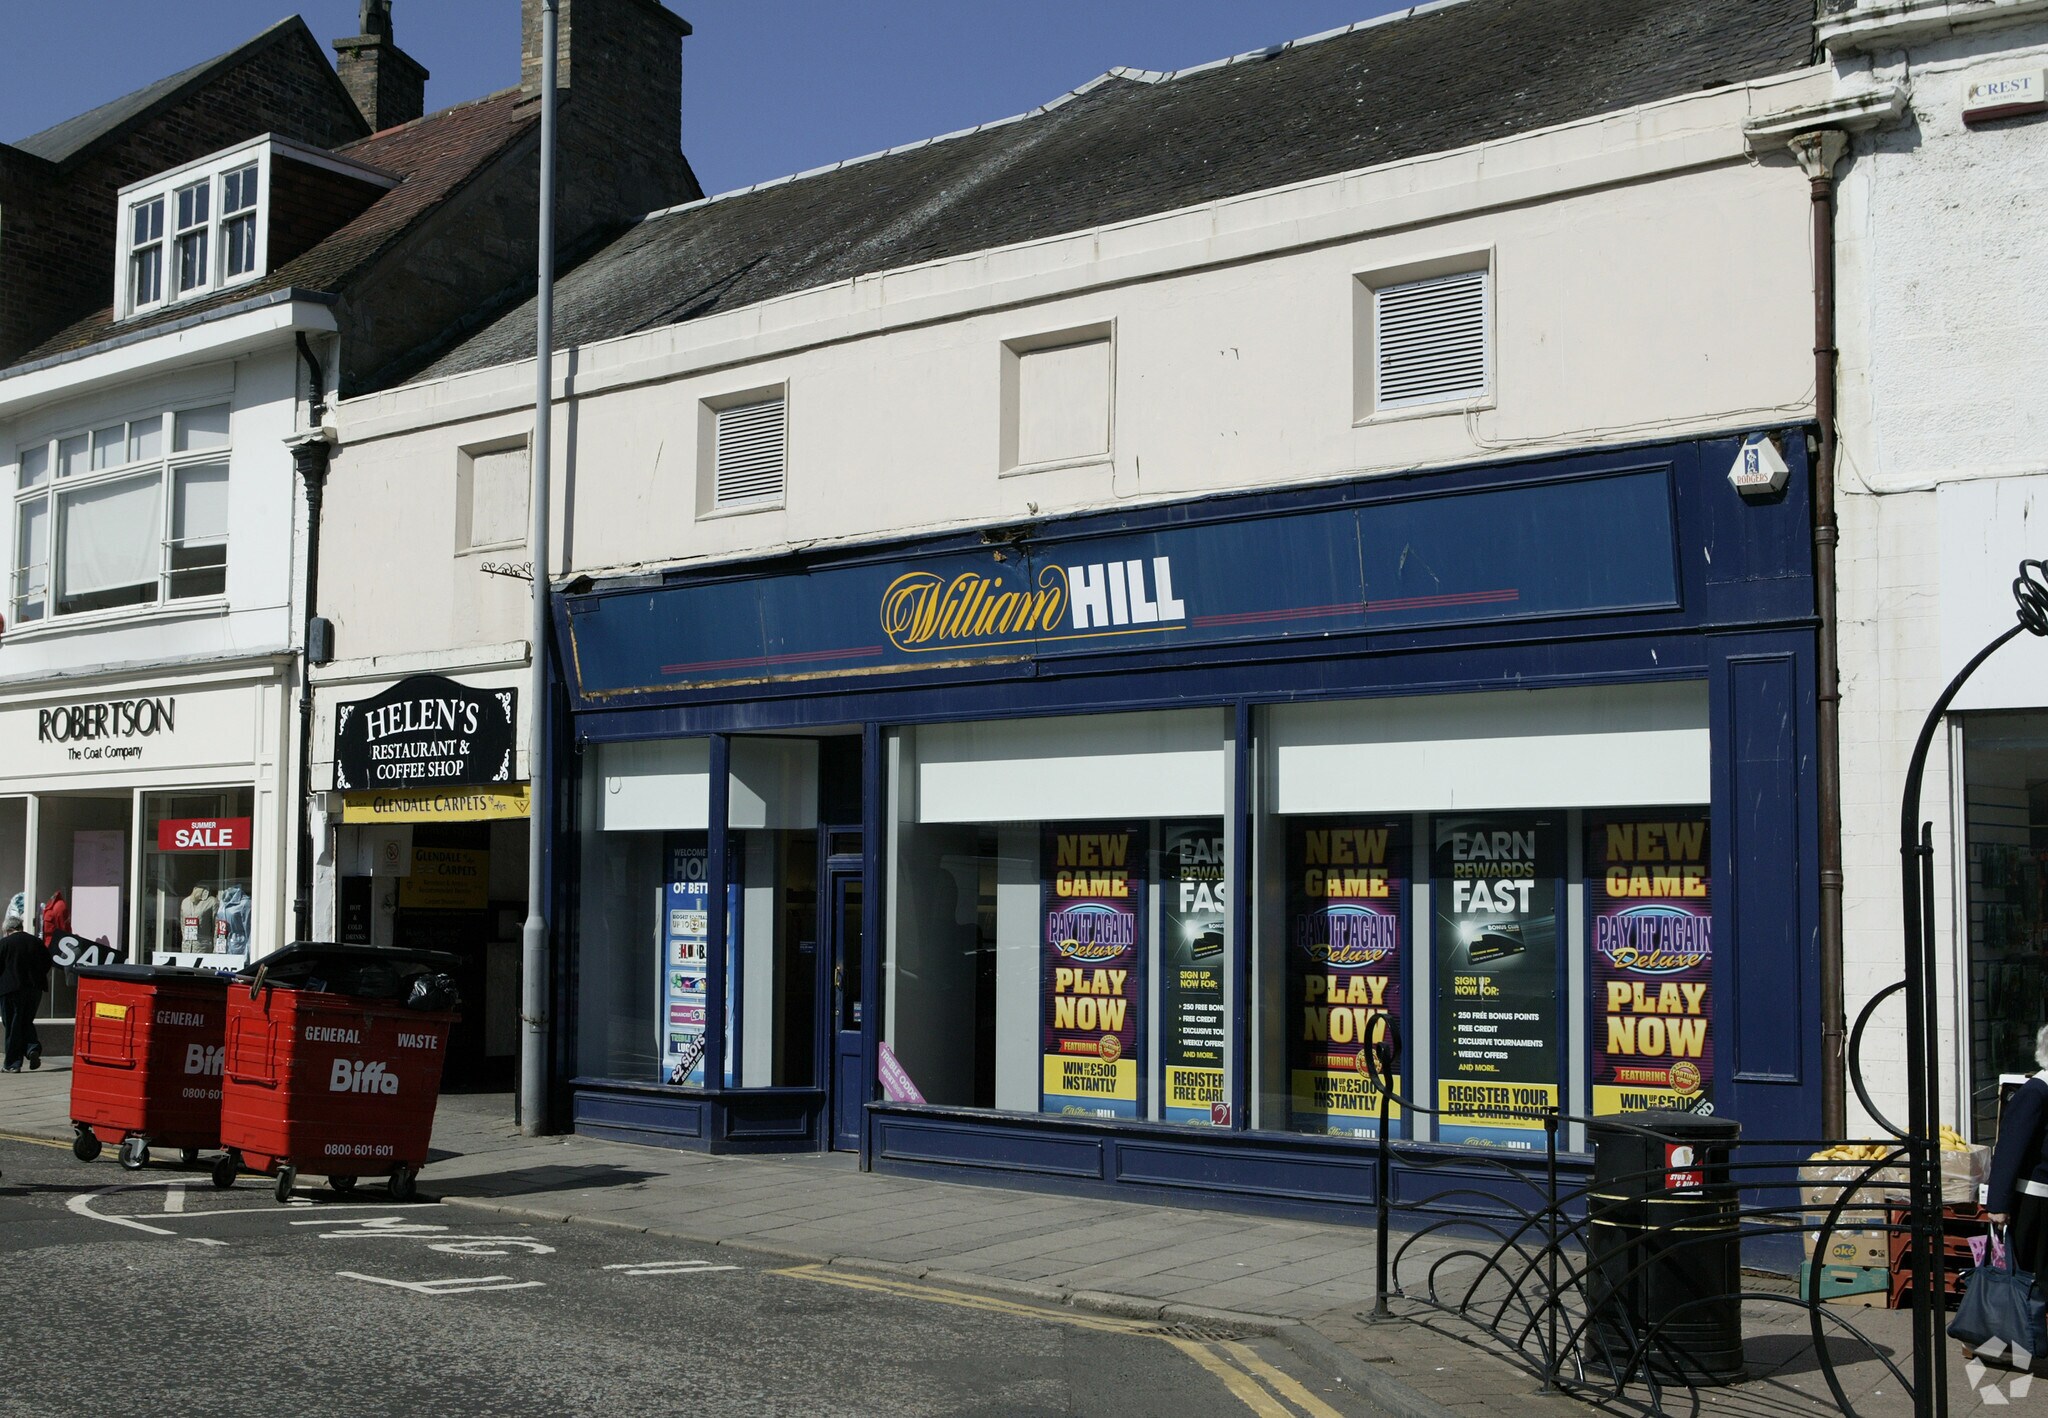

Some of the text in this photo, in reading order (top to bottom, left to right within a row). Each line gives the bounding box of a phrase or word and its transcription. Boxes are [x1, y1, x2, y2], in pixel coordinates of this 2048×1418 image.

[1975, 77, 2032, 98] CREST
[1736, 472, 1769, 485] RODGERS
[880, 556, 1186, 645] William HILL
[38, 697, 175, 743] ROBERTSON
[365, 698, 480, 742] HELEN'S
[68, 745, 143, 760] The Coat Company
[372, 739, 470, 760] RESTAURANT &
[376, 760, 464, 780] COFFEE SHOP
[373, 796, 431, 814] GLENDALE
[434, 794, 487, 812] CARPETS
[191, 821, 217, 829] SUMMER
[175, 828, 233, 848] SALE
[1304, 829, 1389, 865] NEW
[1452, 831, 1535, 861] EARN
[1605, 822, 1706, 861] NEW
[416, 849, 461, 863] GLENDALE
[674, 848, 707, 857] WELCOME
[1056, 834, 1129, 867] NEW
[1179, 838, 1224, 865] EAR
[438, 863, 477, 876] CARPETS
[1453, 862, 1535, 878] REWARDS
[673, 883, 686, 894] OF
[1056, 871, 1129, 897] GAME
[1304, 868, 1389, 897] GAME
[1605, 865, 1706, 897] GAME
[1179, 882, 1224, 913] FAS
[1453, 879, 1534, 914] FAST
[1049, 911, 1134, 944] PAY IT AGAIN
[1329, 914, 1347, 947] IT
[1350, 914, 1396, 948] AGAIN
[1597, 915, 1712, 953] PAY IT AGAIN
[1060, 939, 1125, 957] Deluxe
[1311, 943, 1383, 962] Deluxe
[1612, 946, 1701, 968] Deluxe
[1055, 967, 1128, 996] PLAY
[1180, 971, 1199, 979] SIGN
[1180, 980, 1218, 988] NOW FOR:
[1454, 977, 1476, 985] SIGN
[1304, 974, 1388, 1005] PLAY
[1454, 986, 1477, 995] NOW
[1606, 980, 1707, 1015] PLAY
[1055, 996, 1127, 1032] NOW
[1196, 1015, 1217, 1023] CREDIT
[1458, 1011, 1540, 1021] 250 FREE BONUS POINTS
[1303, 1006, 1389, 1044] NOW
[1474, 1025, 1498, 1033] CREDIT
[397, 1033, 438, 1049] WASTE
[1064, 1041, 1097, 1052] FEATURING
[1458, 1037, 1543, 1047] EXCLUSIVE TOURNAMENTS
[1606, 1016, 1707, 1058] NOW
[184, 1043, 225, 1076] Bif
[681, 1034, 706, 1068] SLOTS
[1315, 1055, 1354, 1067] FEATURING
[1458, 1050, 1508, 1060] WEEKLY OFFERS
[329, 1058, 399, 1095] Biffa
[881, 1048, 901, 1078] TREBLE
[899, 1075, 918, 1100] ODDS
[1063, 1061, 1083, 1075] WIN
[1091, 1063, 1117, 1077] £500
[1458, 1064, 1474, 1072] AND
[1620, 1070, 1667, 1082] FEATURING
[1062, 1075, 1117, 1093] INSTANTLY
[1173, 1087, 1196, 1100] FREE
[1314, 1077, 1338, 1092] WIN
[1347, 1078, 1377, 1094] £500
[1314, 1092, 1377, 1111] INSTANTLY
[1448, 1085, 1549, 1106] REGISTER YOUR
[1620, 1093, 1648, 1109] WIN
